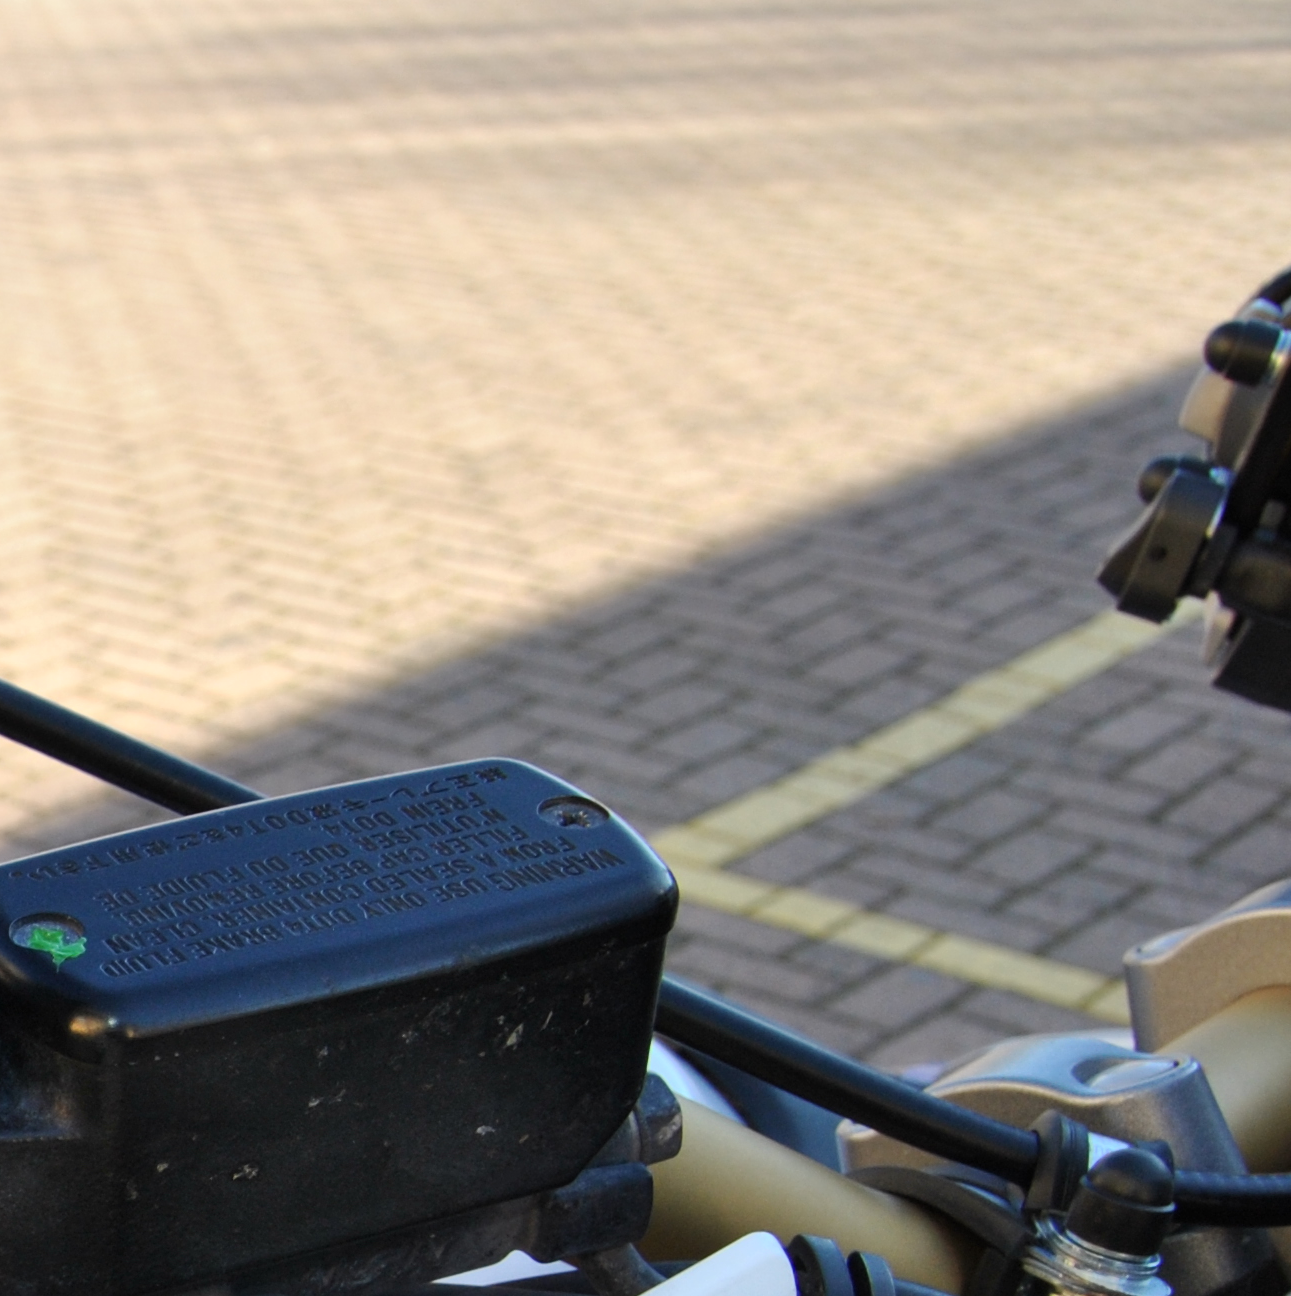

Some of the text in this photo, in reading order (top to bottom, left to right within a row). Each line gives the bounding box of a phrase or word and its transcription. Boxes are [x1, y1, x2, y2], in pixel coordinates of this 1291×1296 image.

[309, 791, 487, 837] FREIN DOT4.
[288, 843, 349, 867] QUE
[429, 825, 529, 856] FILLER
[245, 855, 290, 877] DU
[378, 847, 430, 869] CAP
[139, 866, 246, 901] FLUIDE
[260, 859, 374, 895] BEFORE
[93, 888, 140, 912] DE
[102, 836, 577, 954] FROM A SEALED CONTAINER. CLEAN
[100, 848, 626, 977] WARNING USE ONLY DOT4 BRAKE FLUID
